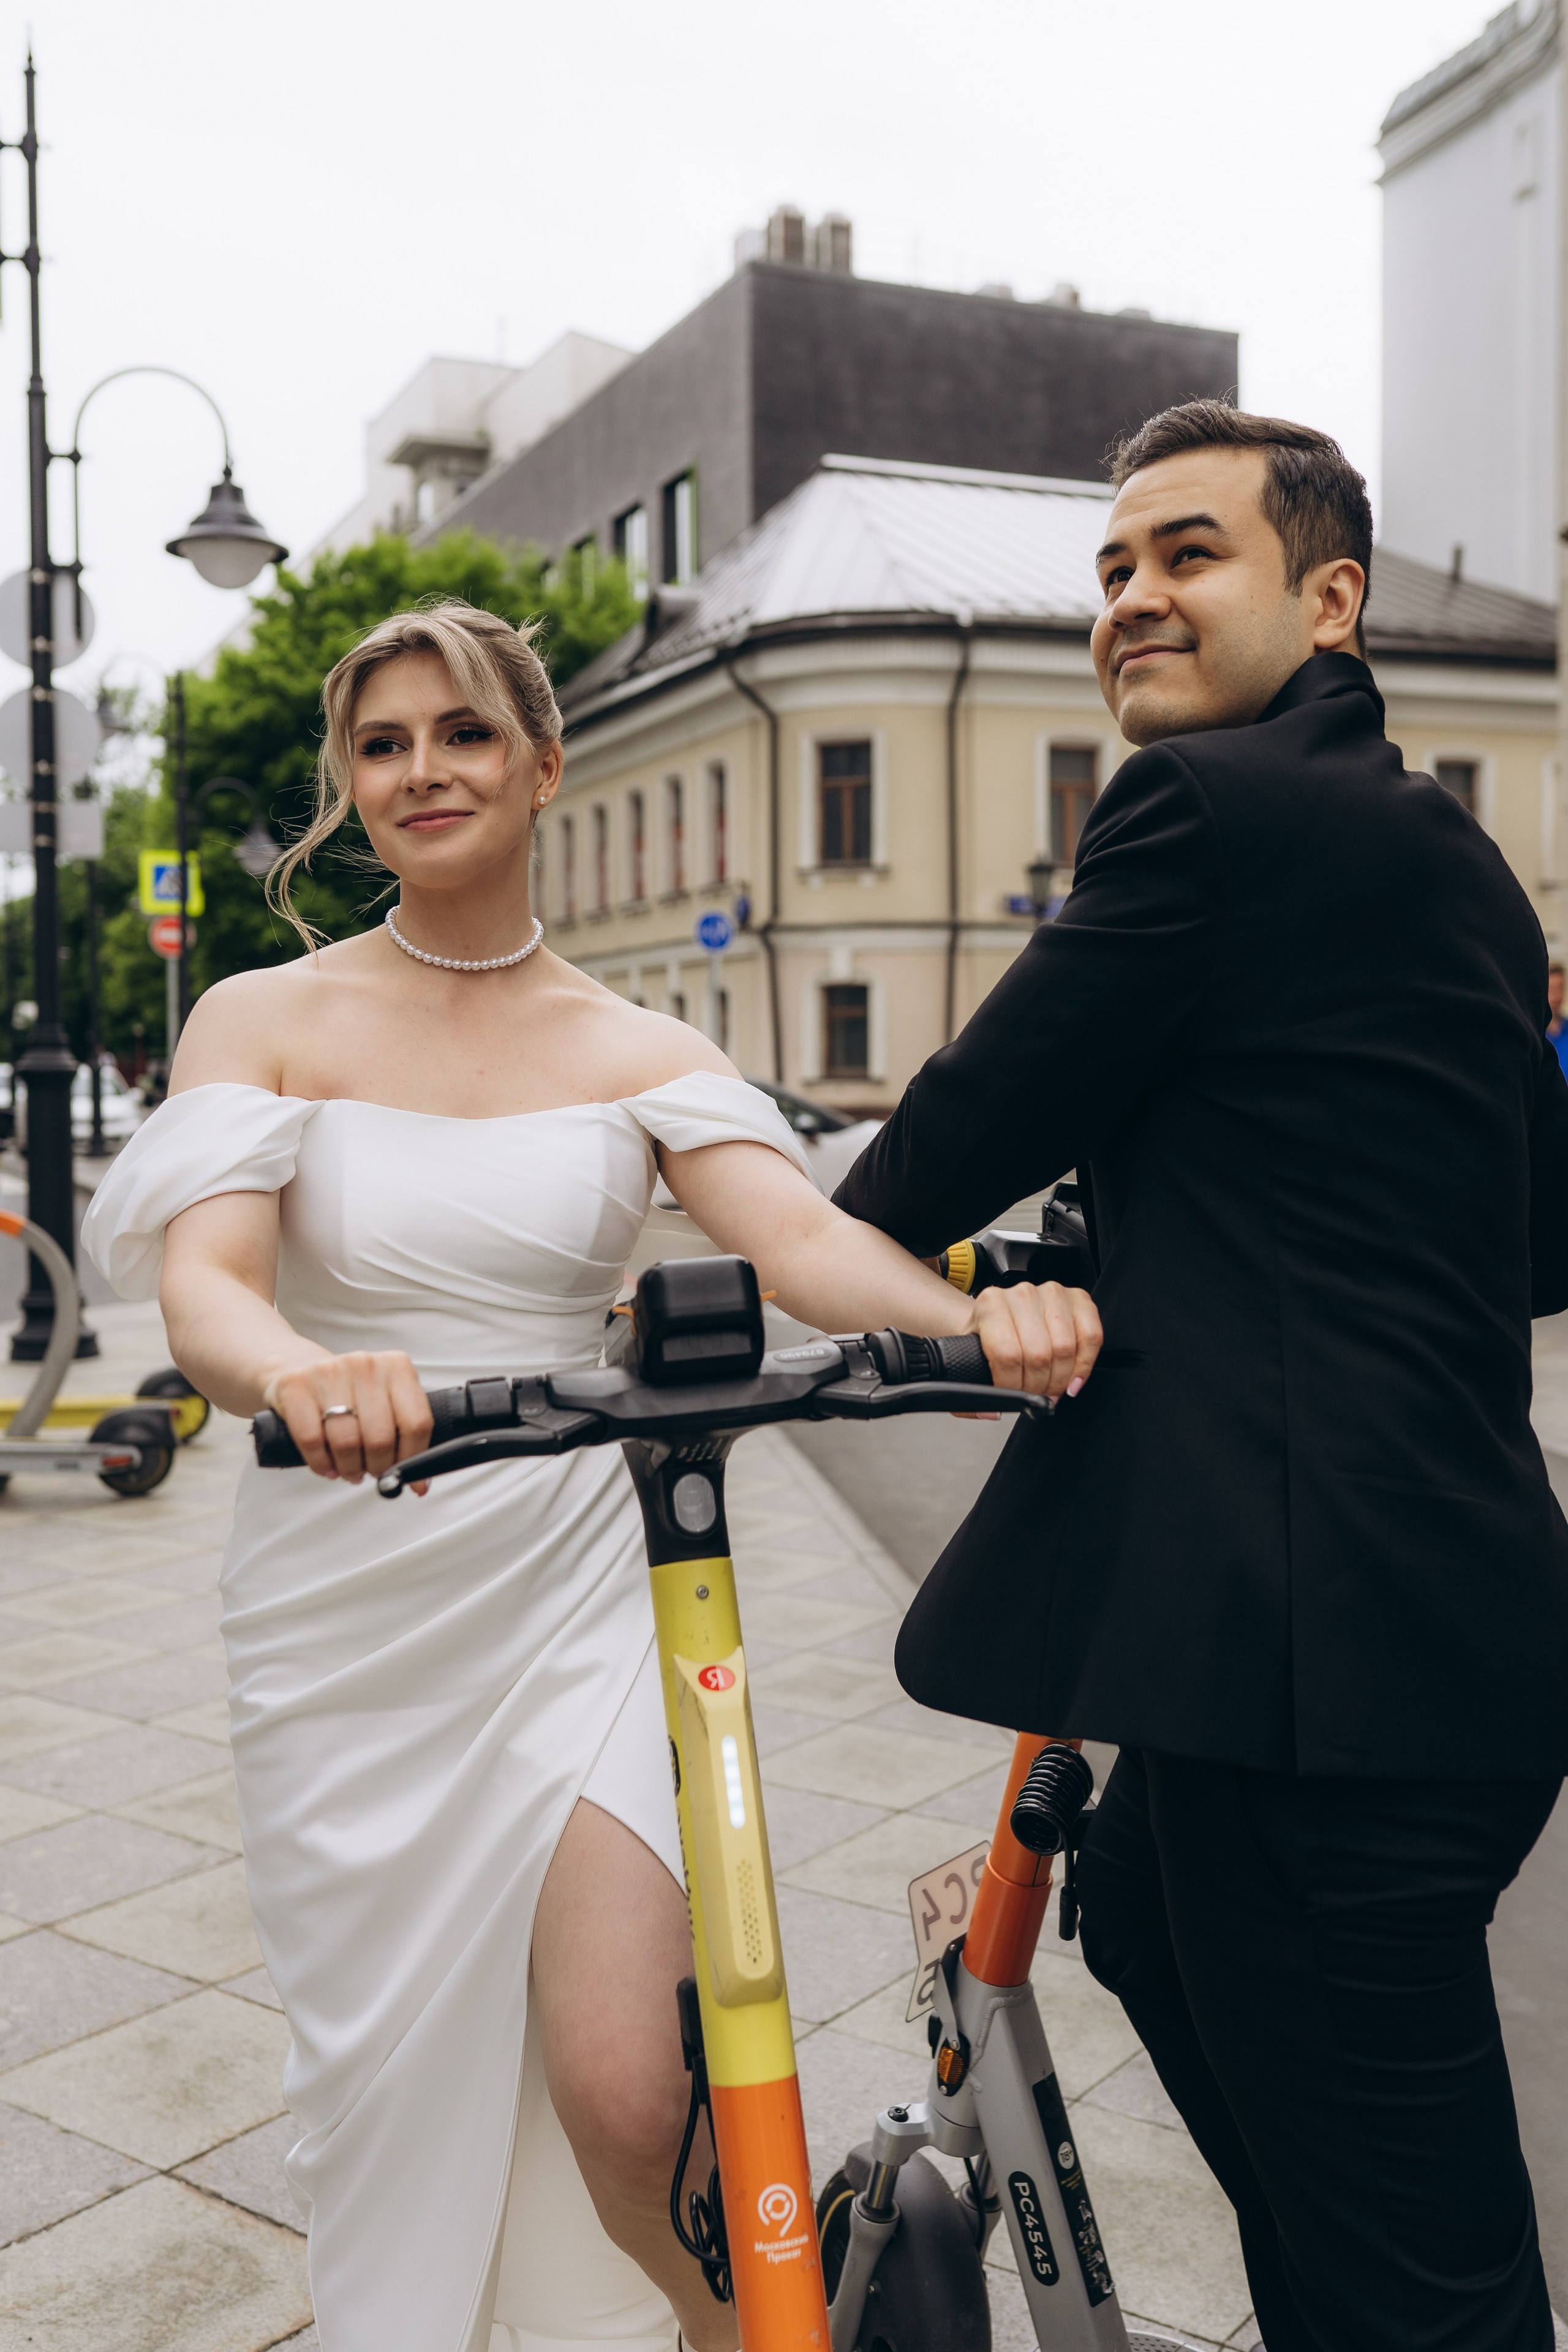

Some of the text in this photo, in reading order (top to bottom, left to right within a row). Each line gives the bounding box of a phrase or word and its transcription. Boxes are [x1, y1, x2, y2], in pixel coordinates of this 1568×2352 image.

[706, 1668, 725, 1689] Я
[1014, 2182, 1052, 2275] PC4545
[755, 2232, 809, 2253] Московский
[766, 2248, 801, 2265] Прокат
